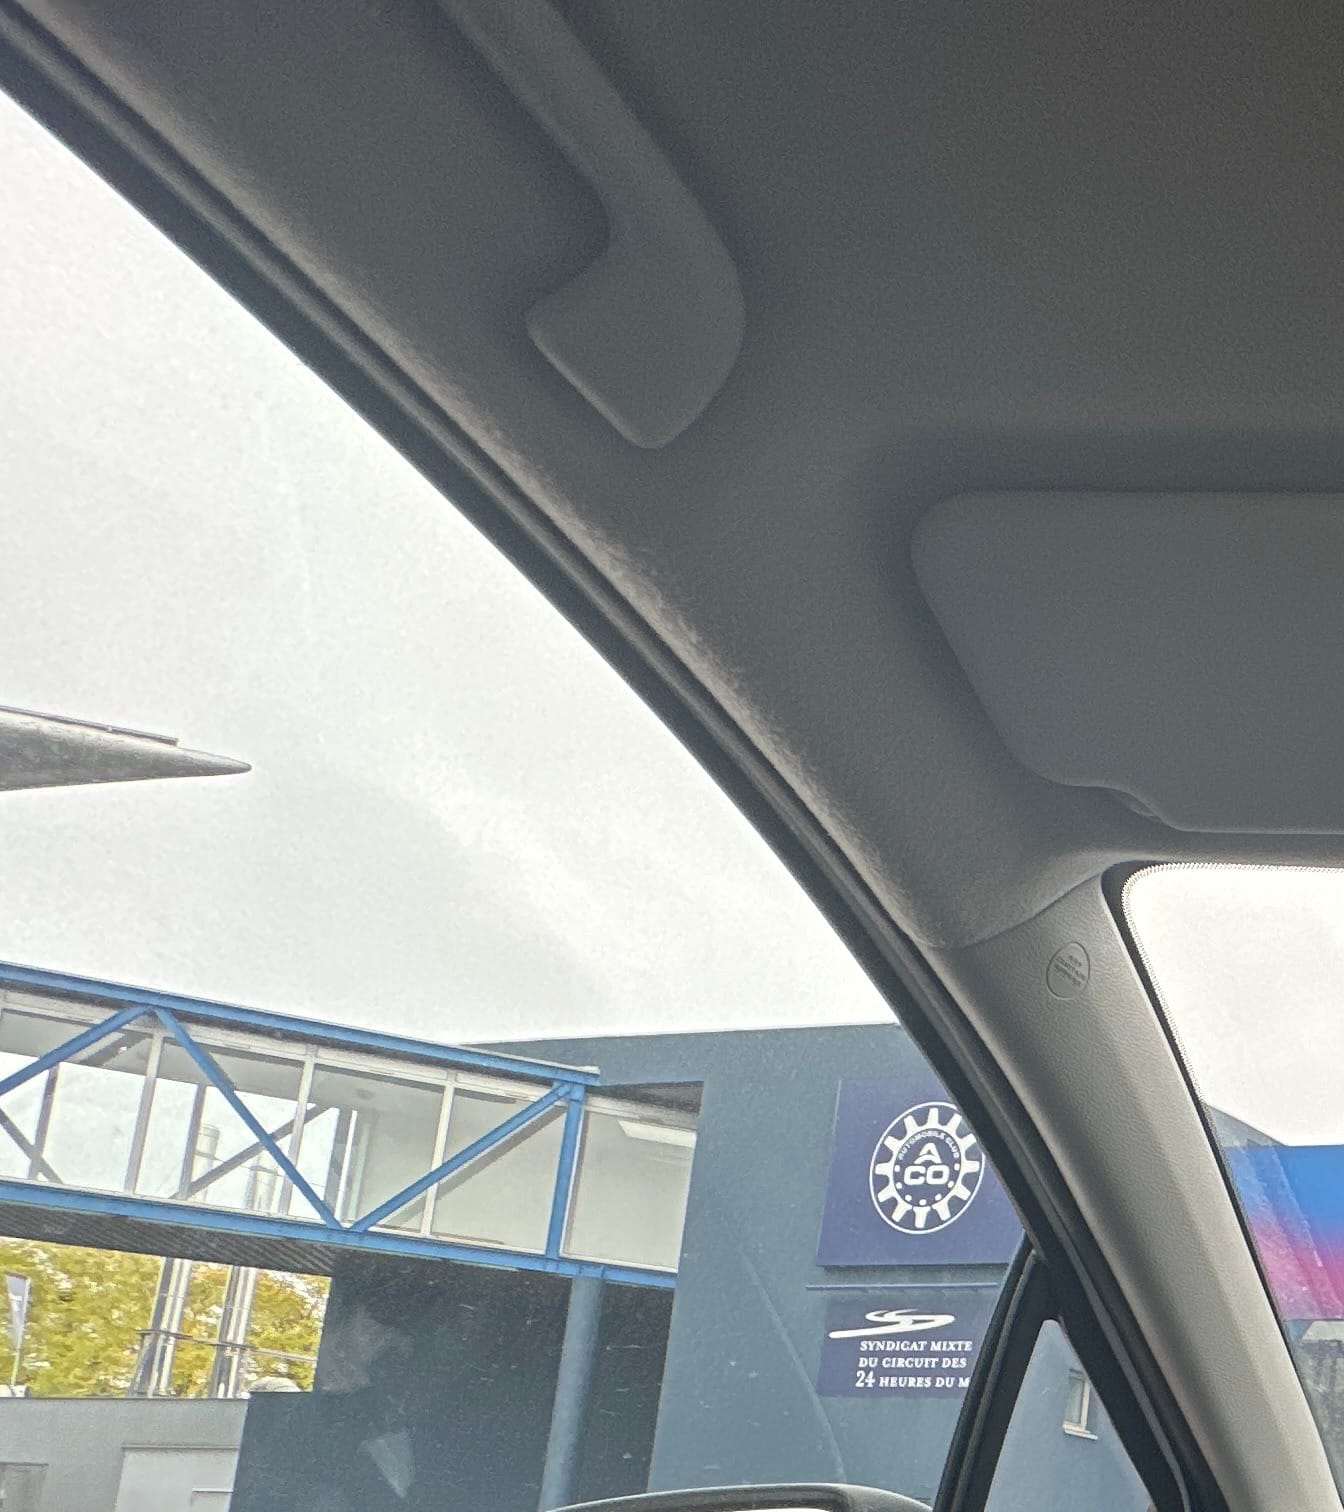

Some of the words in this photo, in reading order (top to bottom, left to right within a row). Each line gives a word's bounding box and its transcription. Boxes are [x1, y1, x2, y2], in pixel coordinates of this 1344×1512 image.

[860, 1340, 927, 1352] SYNDICAT
[930, 1340, 973, 1352] MIXTE
[858, 1357, 878, 1368] DU
[882, 1357, 938, 1368] CIRCUIT
[941, 1357, 967, 1368] DES
[855, 1370, 875, 1387] 24
[879, 1376, 932, 1388] HEURES
[935, 1376, 954, 1387] DU
